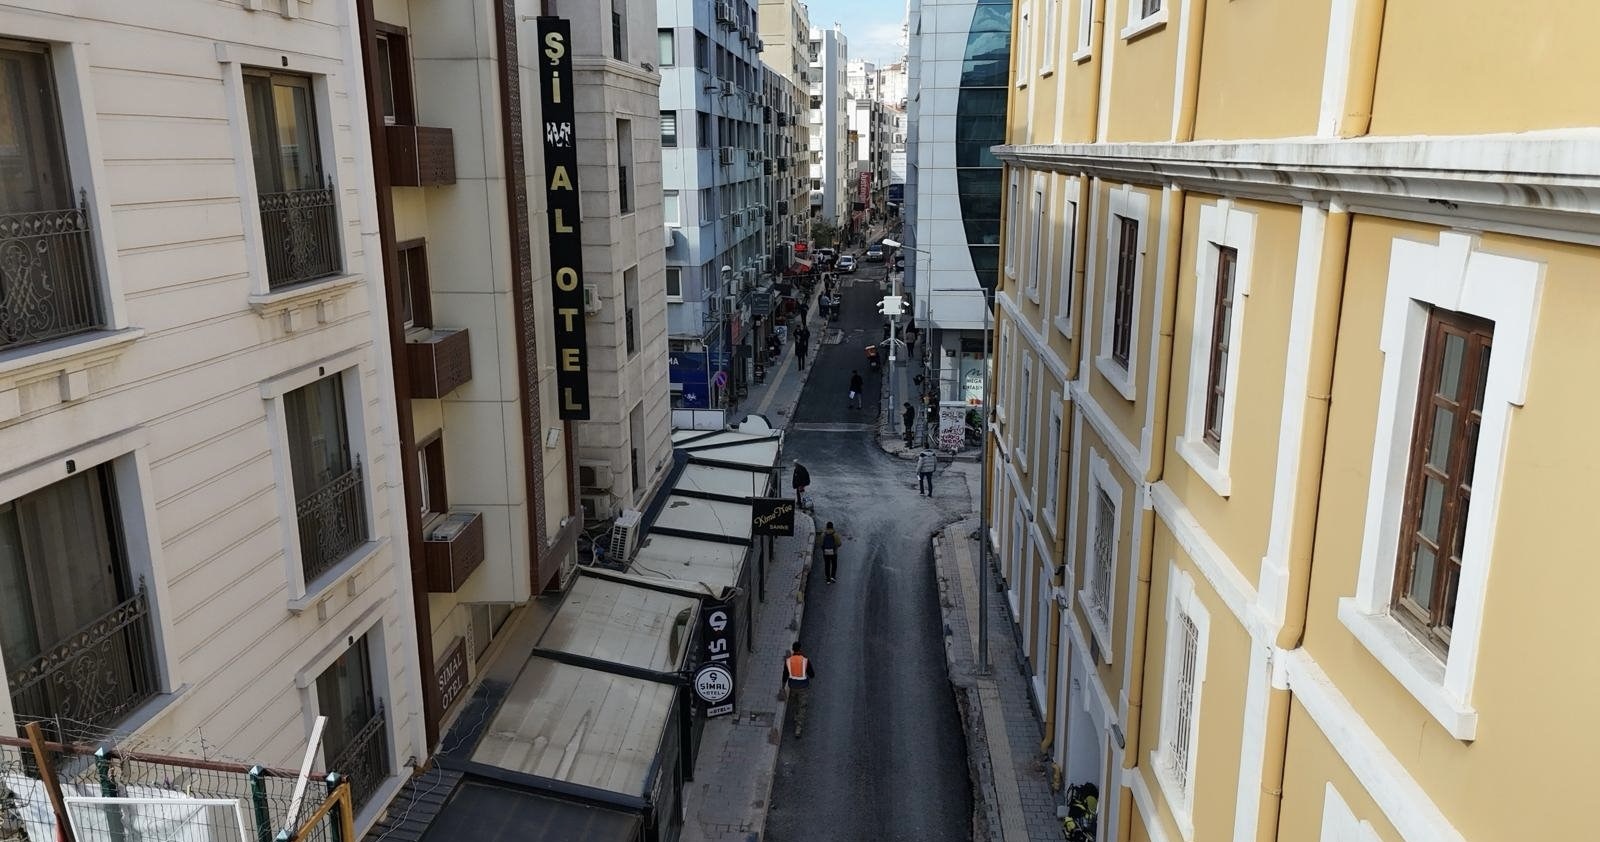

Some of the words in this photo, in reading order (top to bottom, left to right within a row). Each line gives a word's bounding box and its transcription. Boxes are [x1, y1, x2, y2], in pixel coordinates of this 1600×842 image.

[556, 266, 582, 410] OTEL
[442, 675, 463, 709] OTEL
[700, 682, 727, 690] ŞİMAL
